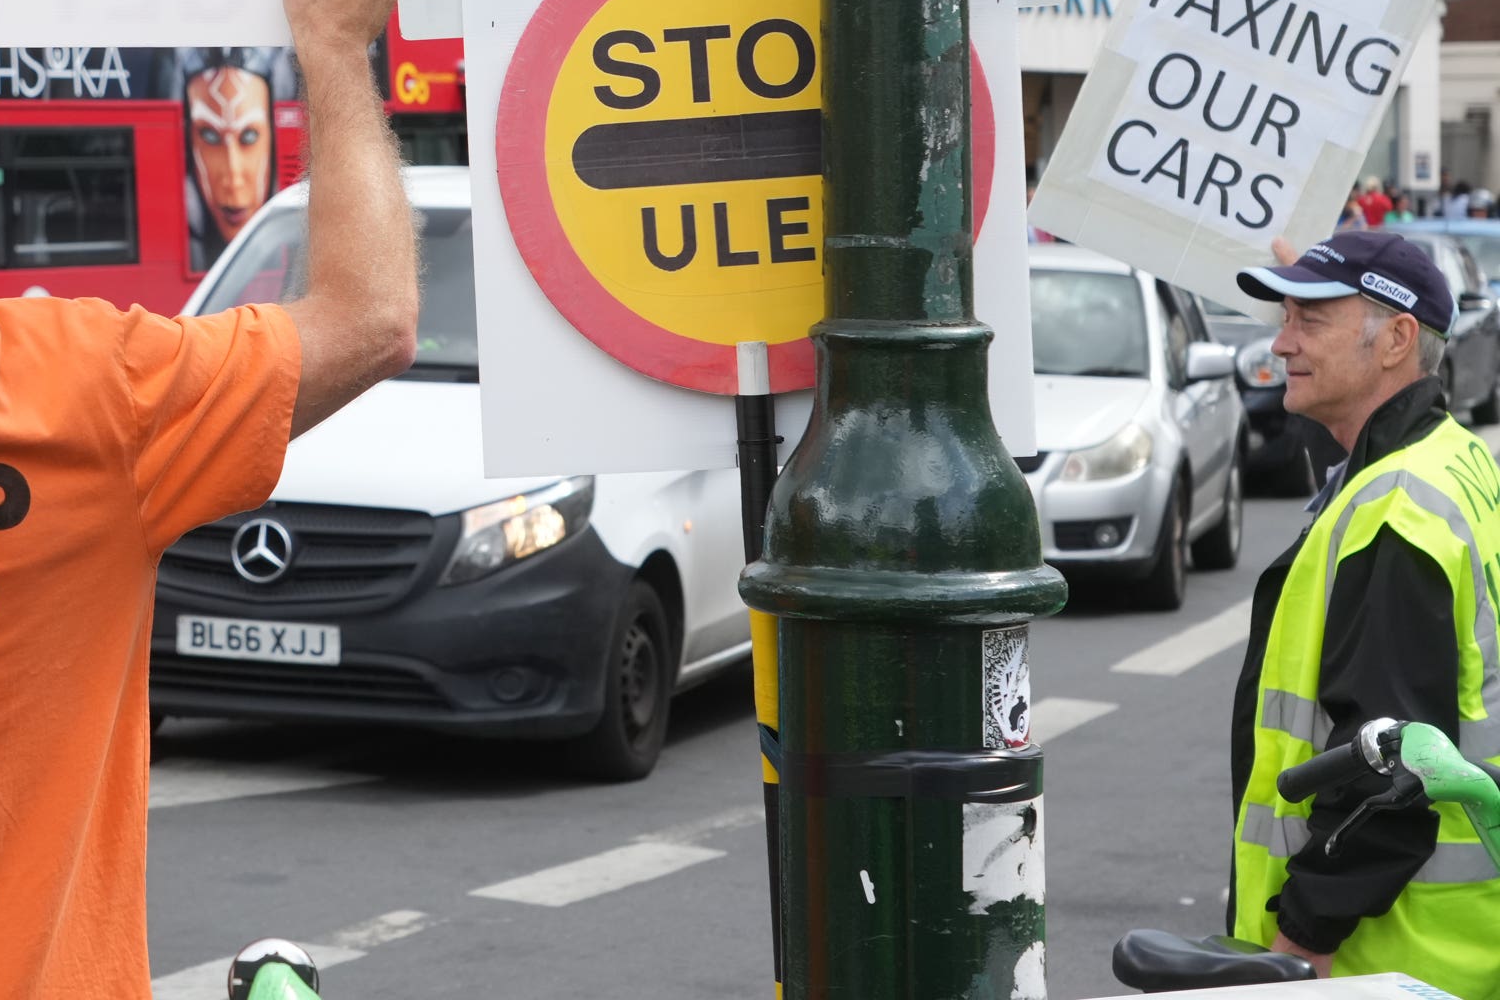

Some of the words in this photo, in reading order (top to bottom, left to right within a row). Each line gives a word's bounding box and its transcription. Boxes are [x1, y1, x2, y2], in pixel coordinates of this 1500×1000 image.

[592, 18, 816, 110] STO
[1148, 53, 1301, 158] OUR
[1106, 120, 1285, 230] CARS
[641, 196, 816, 272] ULE
[1373, 277, 1412, 303] Castrol
[191, 621, 261, 651] BL66
[270, 627, 326, 656] XJJ
